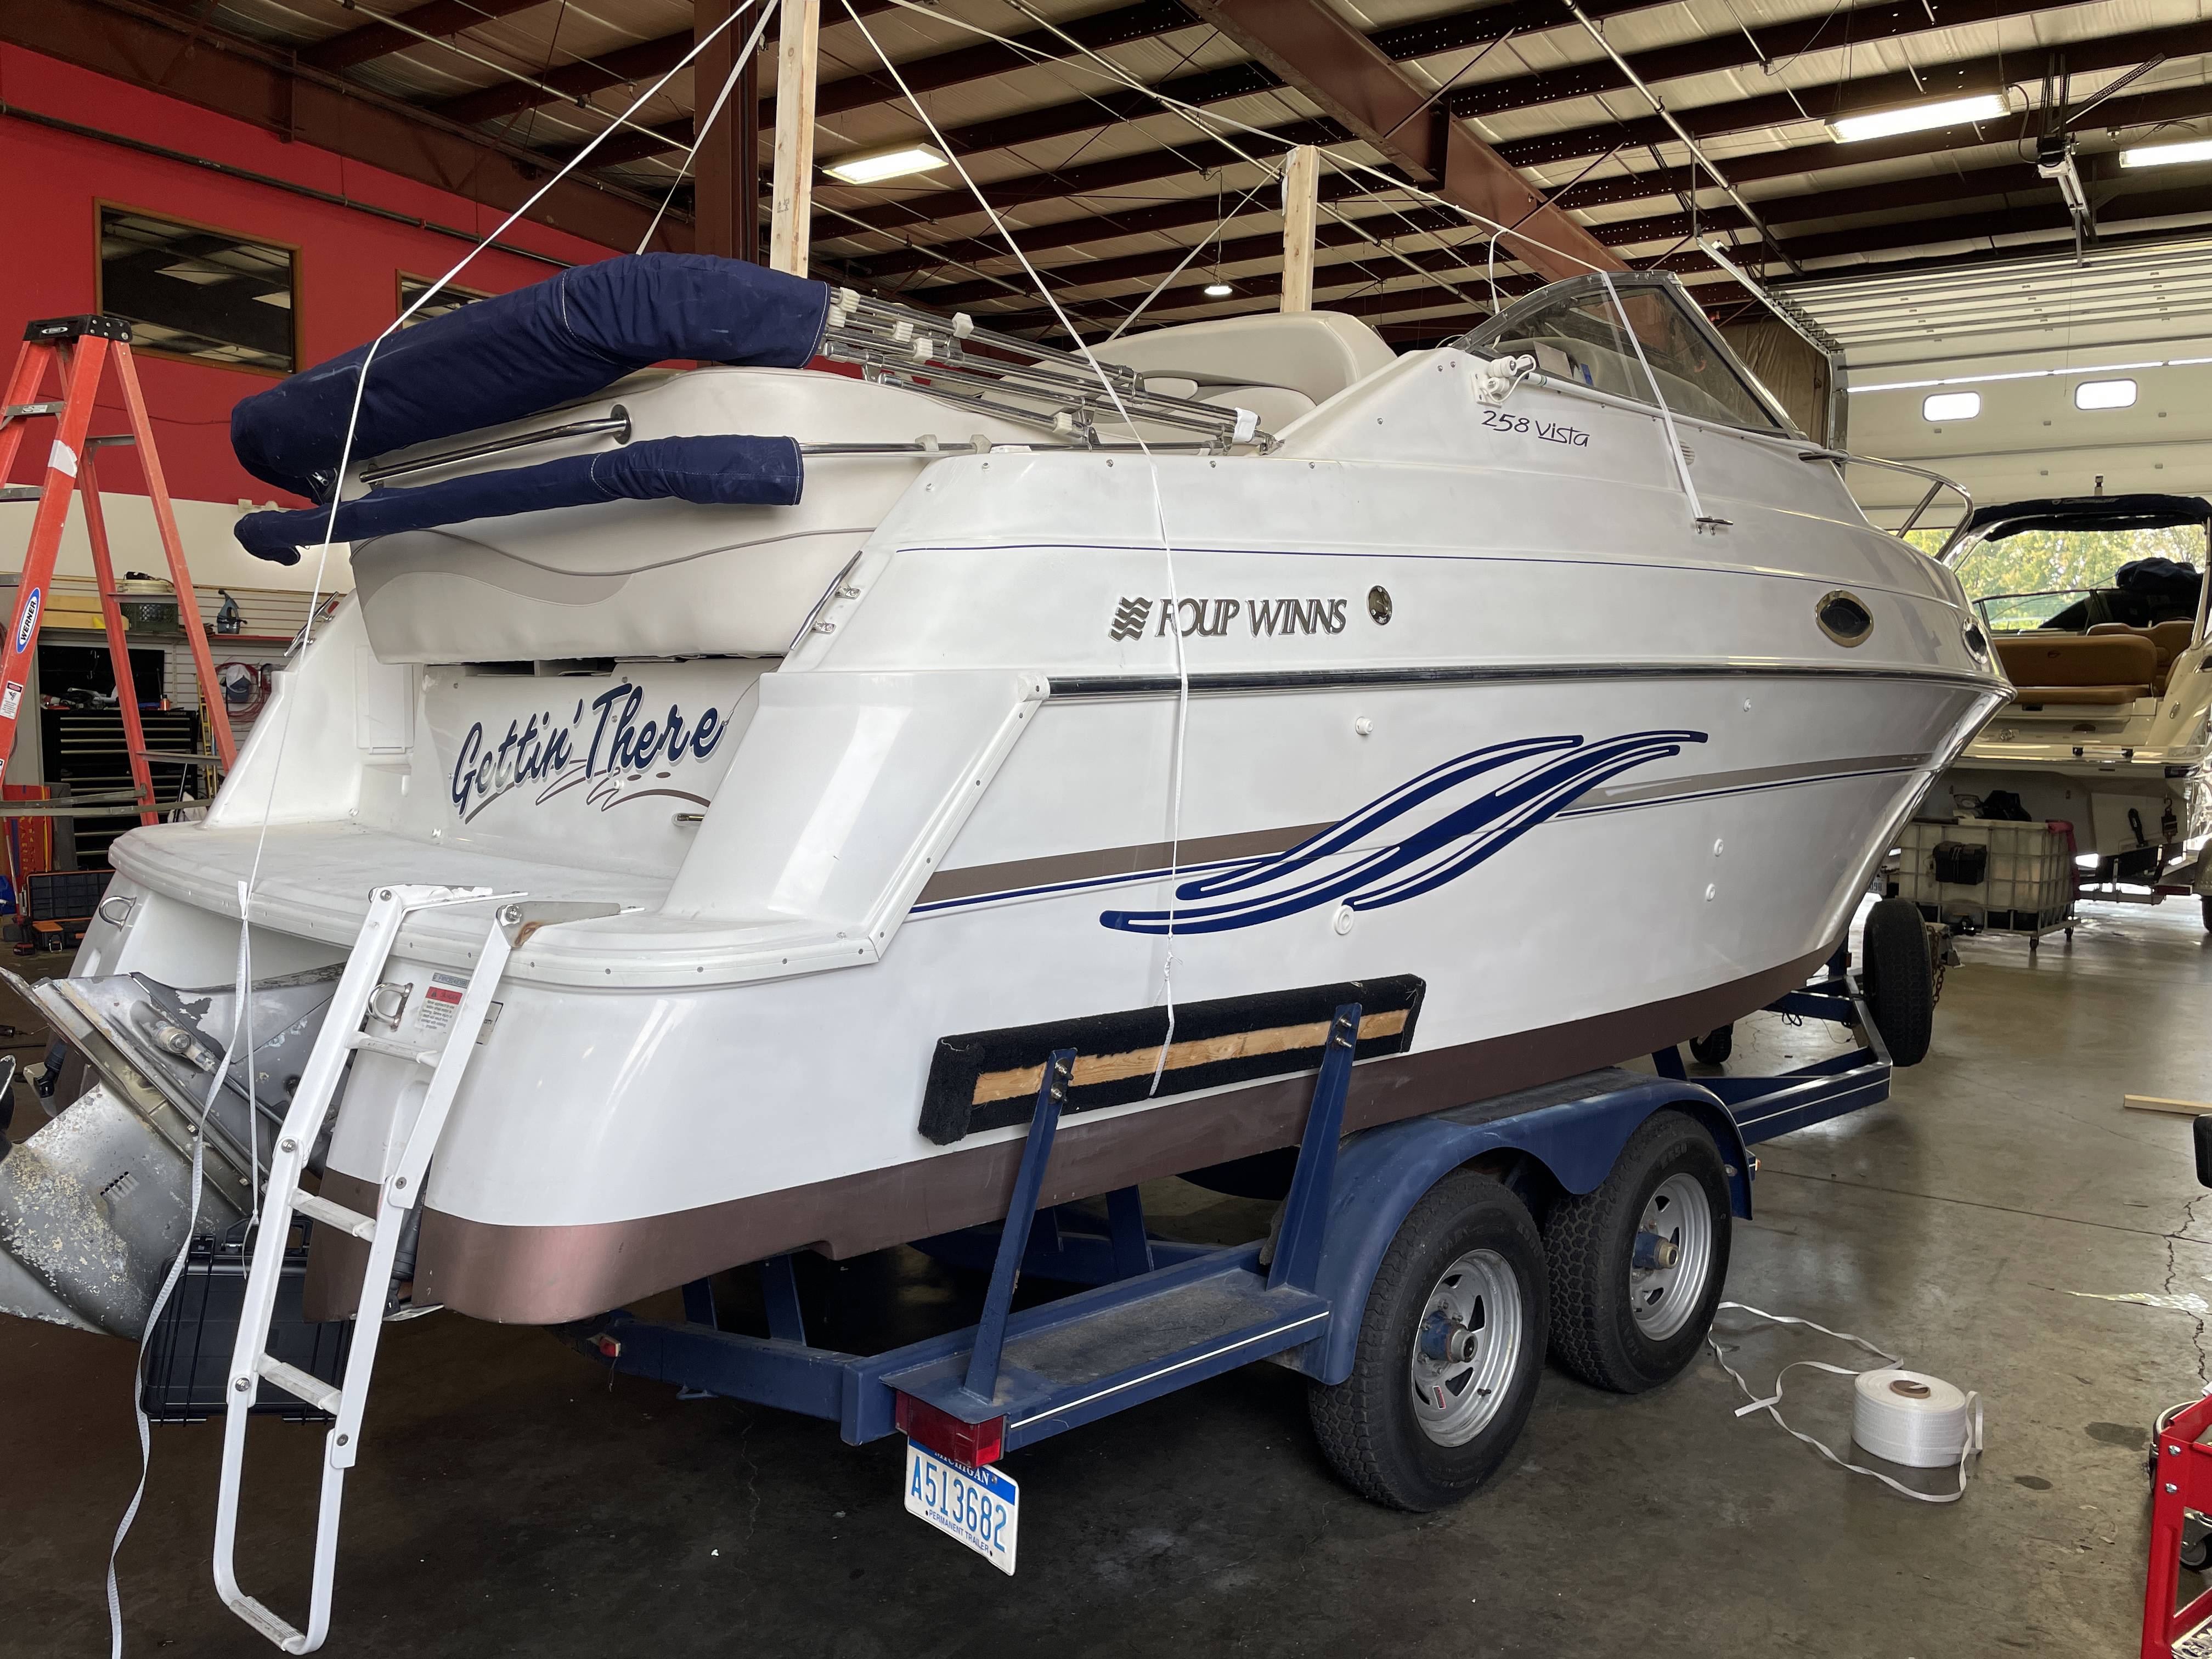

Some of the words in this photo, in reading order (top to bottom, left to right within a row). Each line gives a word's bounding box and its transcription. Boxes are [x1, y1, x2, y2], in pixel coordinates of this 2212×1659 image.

[1481, 410, 1530, 433] 258
[20, 601, 36, 641] WERNER
[1246, 598, 1348, 637] WINNS
[452, 698, 583, 816] Gettin'
[585, 683, 725, 780] There
[934, 1452, 989, 1485] CGAN
[911, 1455, 1007, 1553] A513682
[929, 1509, 964, 1536] PERMANENT
[965, 1531, 989, 1553] TRAILER
